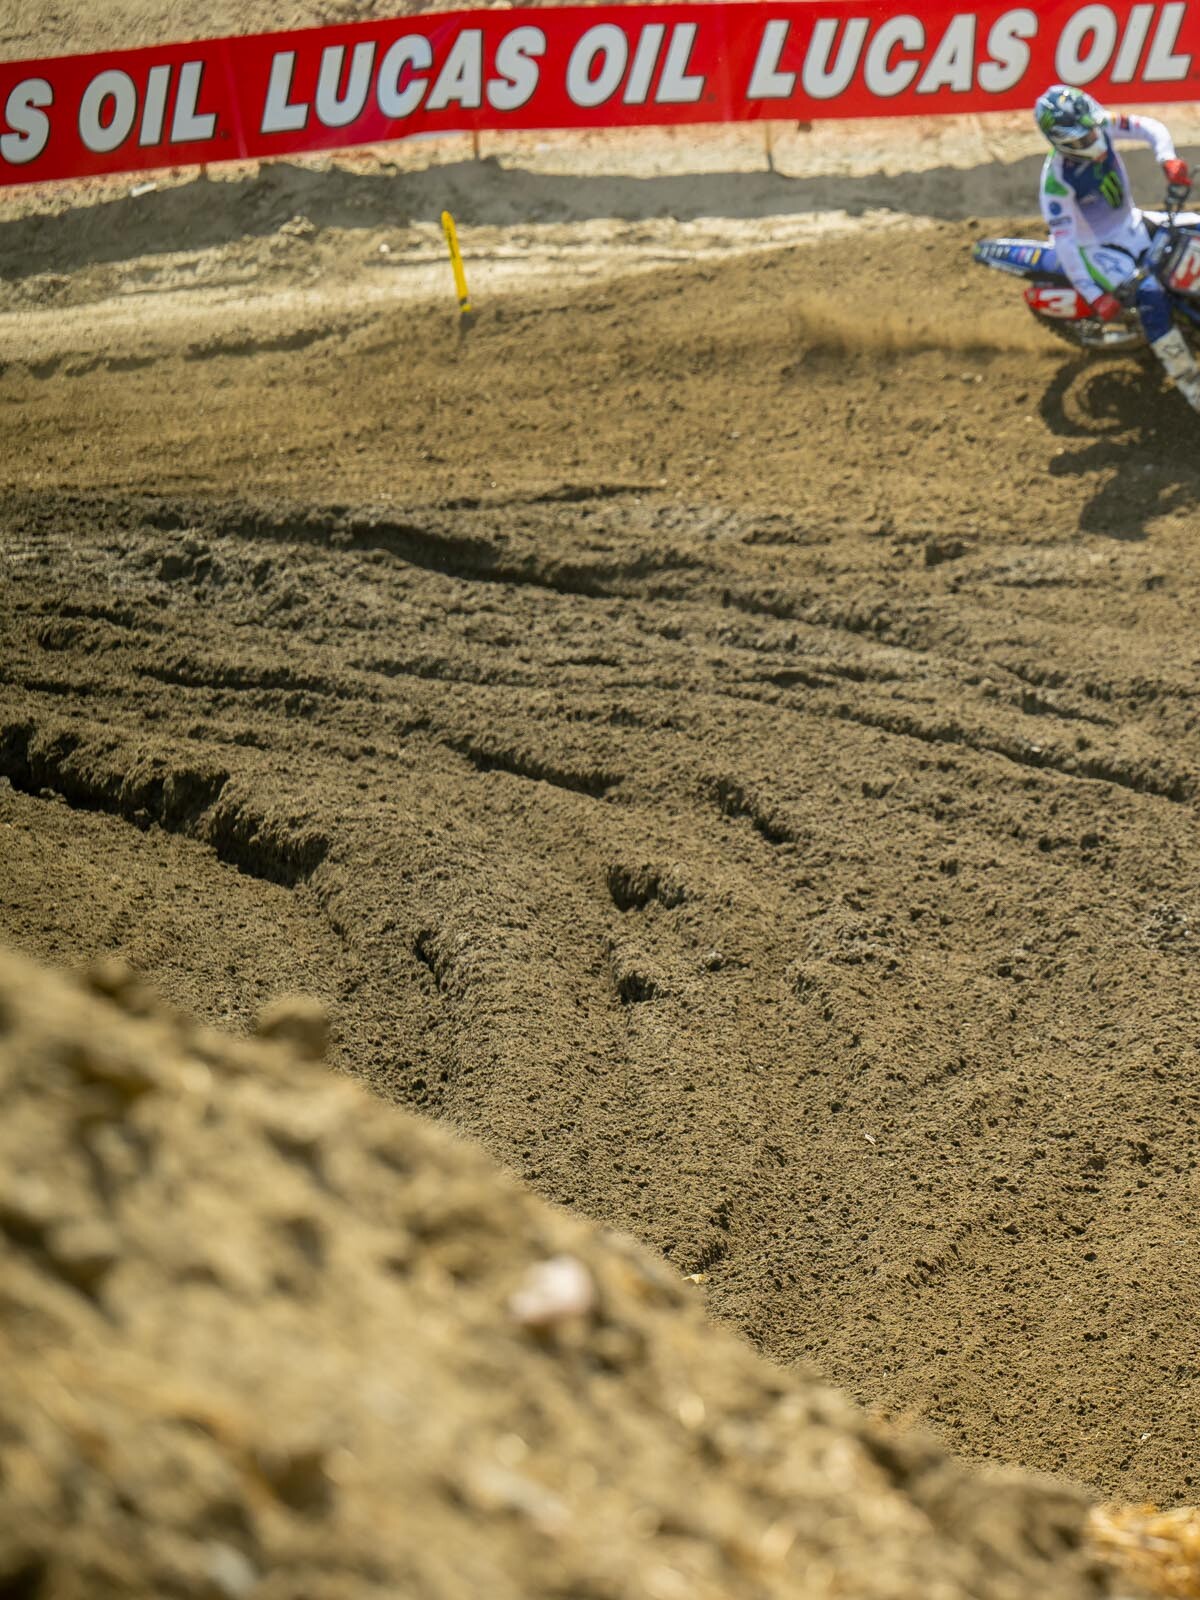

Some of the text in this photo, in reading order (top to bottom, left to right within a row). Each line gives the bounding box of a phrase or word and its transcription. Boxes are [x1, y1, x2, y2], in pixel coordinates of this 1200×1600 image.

[78, 60, 217, 153] OIL
[260, 25, 547, 135] LUCAS
[565, 22, 705, 104] OIL
[747, 8, 1040, 100] LUCAS
[1054, 3, 1193, 86] OIL
[1037, 288, 1078, 318] 3
